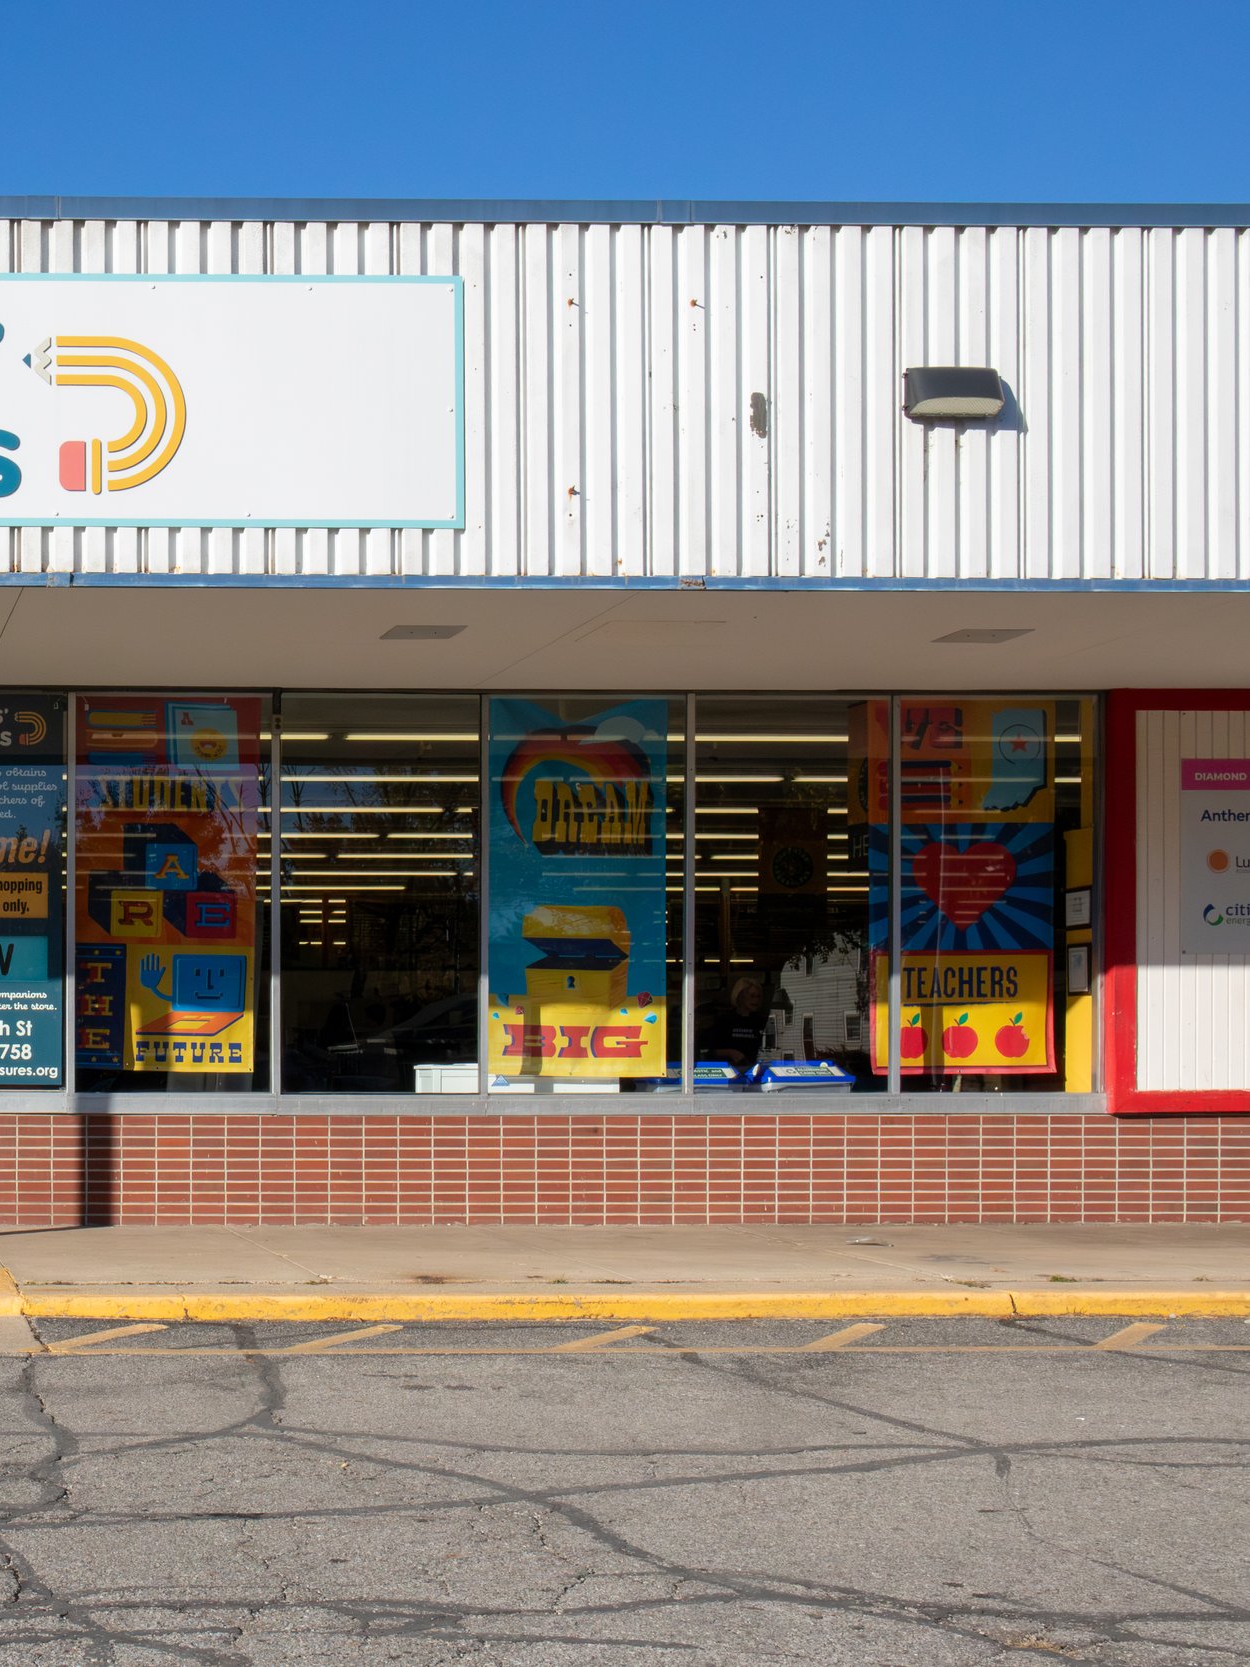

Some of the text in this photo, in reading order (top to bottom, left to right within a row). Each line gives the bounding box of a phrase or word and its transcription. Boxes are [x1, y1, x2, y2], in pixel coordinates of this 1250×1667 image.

[5, 767, 47, 777] obtains
[1194, 772, 1248, 782] DIAMOND
[11, 782, 58, 794] supplies
[31, 796, 45, 807] of
[532, 780, 650, 847] DREAM
[3, 899, 30, 914] only.
[903, 966, 1018, 998] TEACHERS
[14, 1002, 28, 1010] the
[30, 1003, 57, 1011] store.
[15, 1020, 33, 1036] St
[502, 1024, 648, 1058] BIG
[135, 1041, 242, 1064] FUTURE
